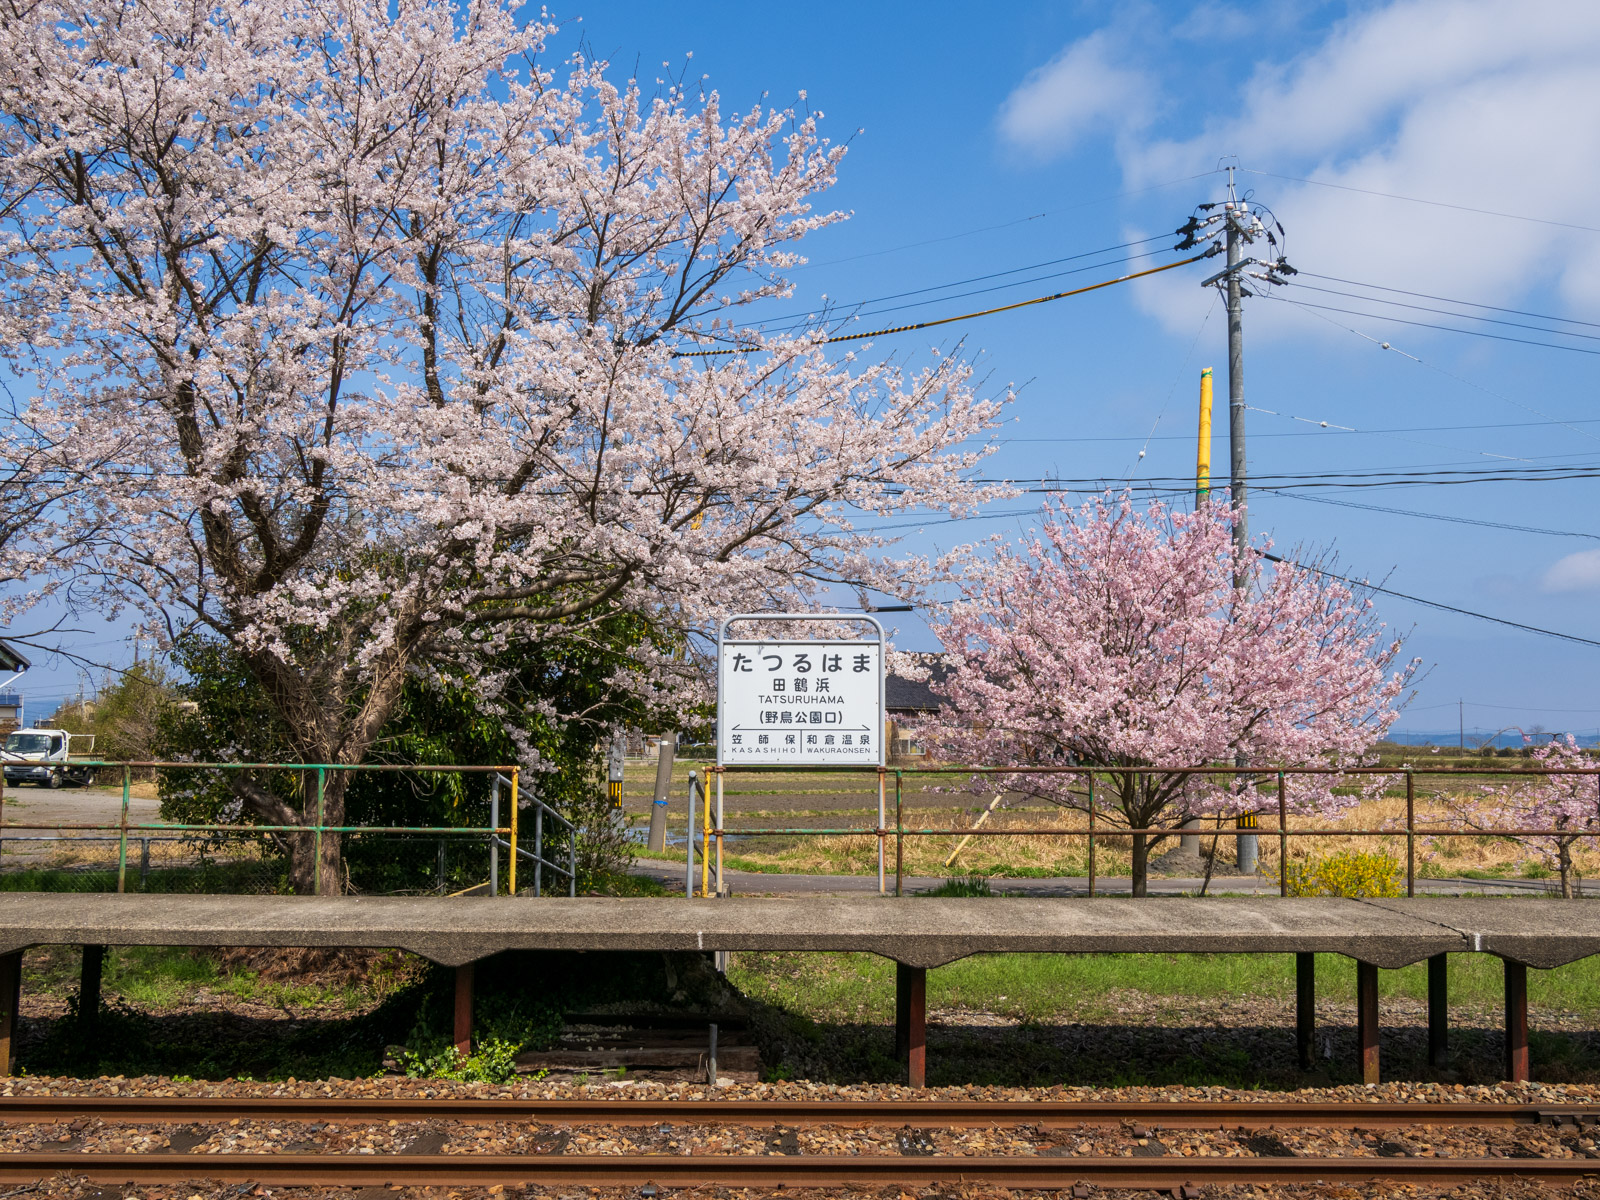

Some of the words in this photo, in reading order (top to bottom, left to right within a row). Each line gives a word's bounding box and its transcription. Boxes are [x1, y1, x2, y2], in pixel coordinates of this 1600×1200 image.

[732, 652, 872, 673] たつるはま
[773, 677, 830, 693] 田鶴浜
[758, 695, 845, 704] TATSURUHAMA
[759, 710, 843, 725] (野鳥公園口)
[731, 734, 796, 745] 笠師保
[806, 734, 871, 745] 和倉温泉
